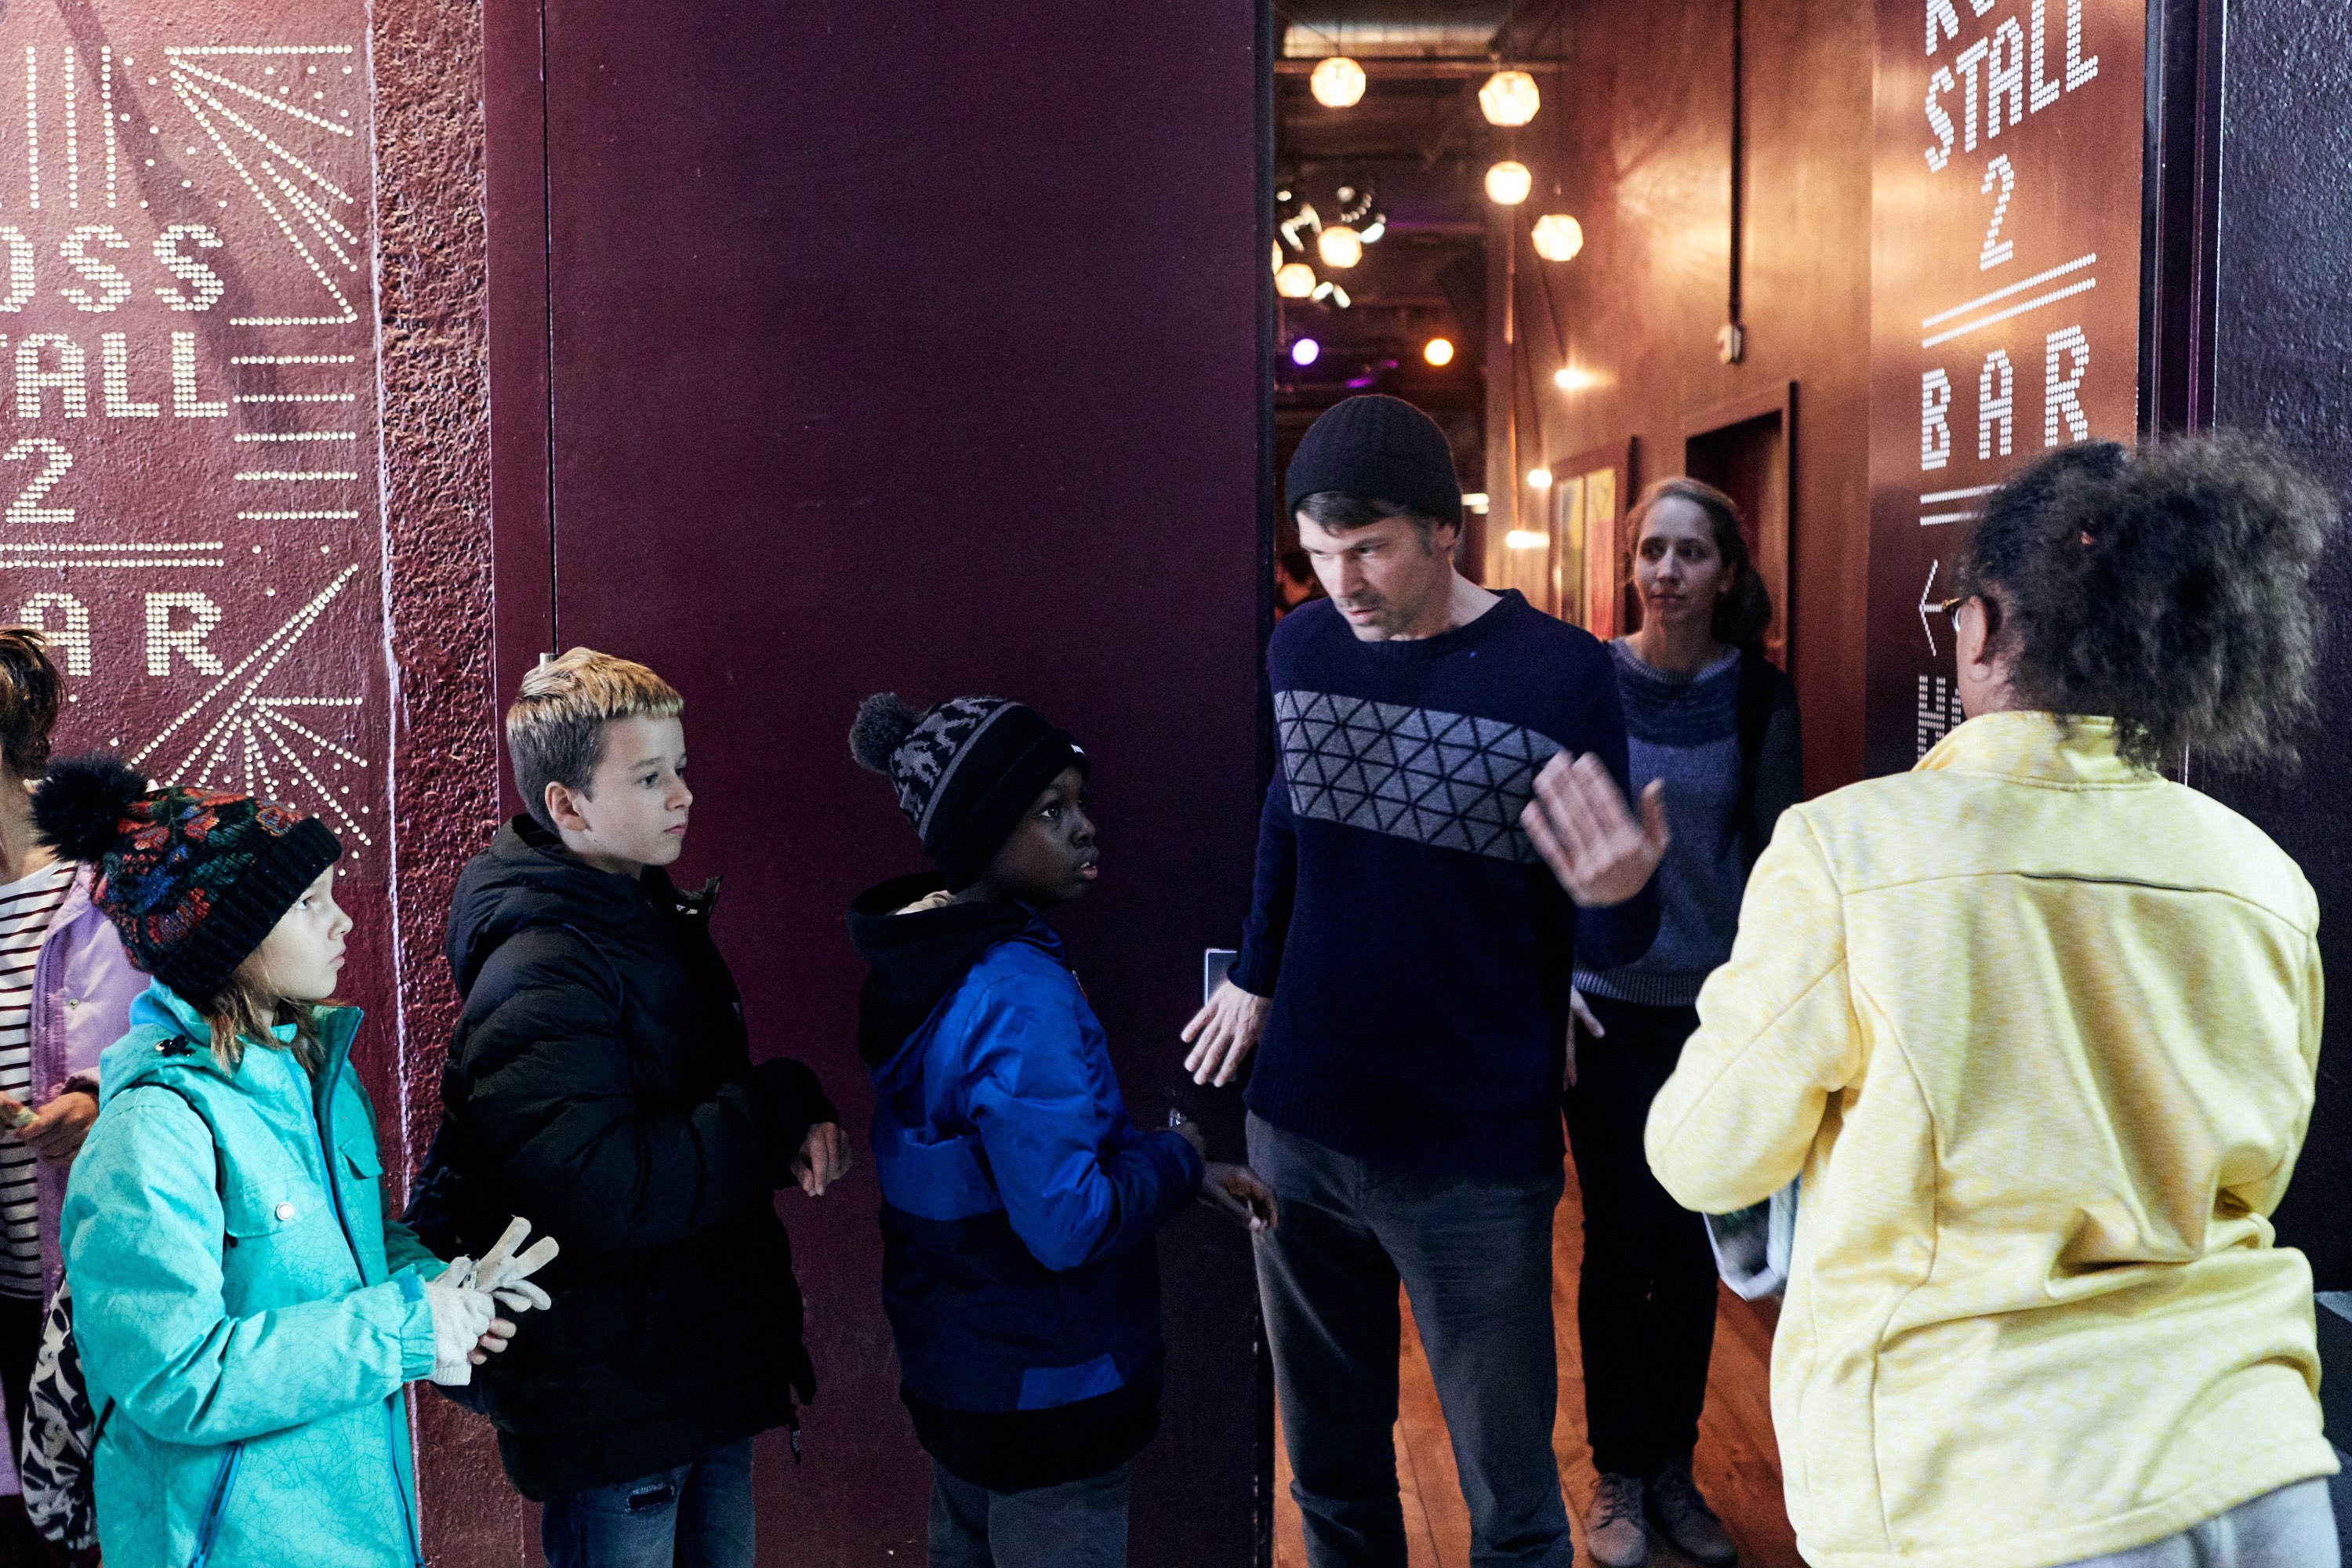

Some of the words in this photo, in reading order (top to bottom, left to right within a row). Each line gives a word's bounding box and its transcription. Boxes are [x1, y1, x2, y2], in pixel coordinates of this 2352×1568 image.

[1926, 0, 2099, 173] STALL
[1980, 154, 2014, 271] 2
[0, 332, 228, 418] ALL
[1922, 325, 2089, 471] BAR
[3, 438, 74, 523] 2
